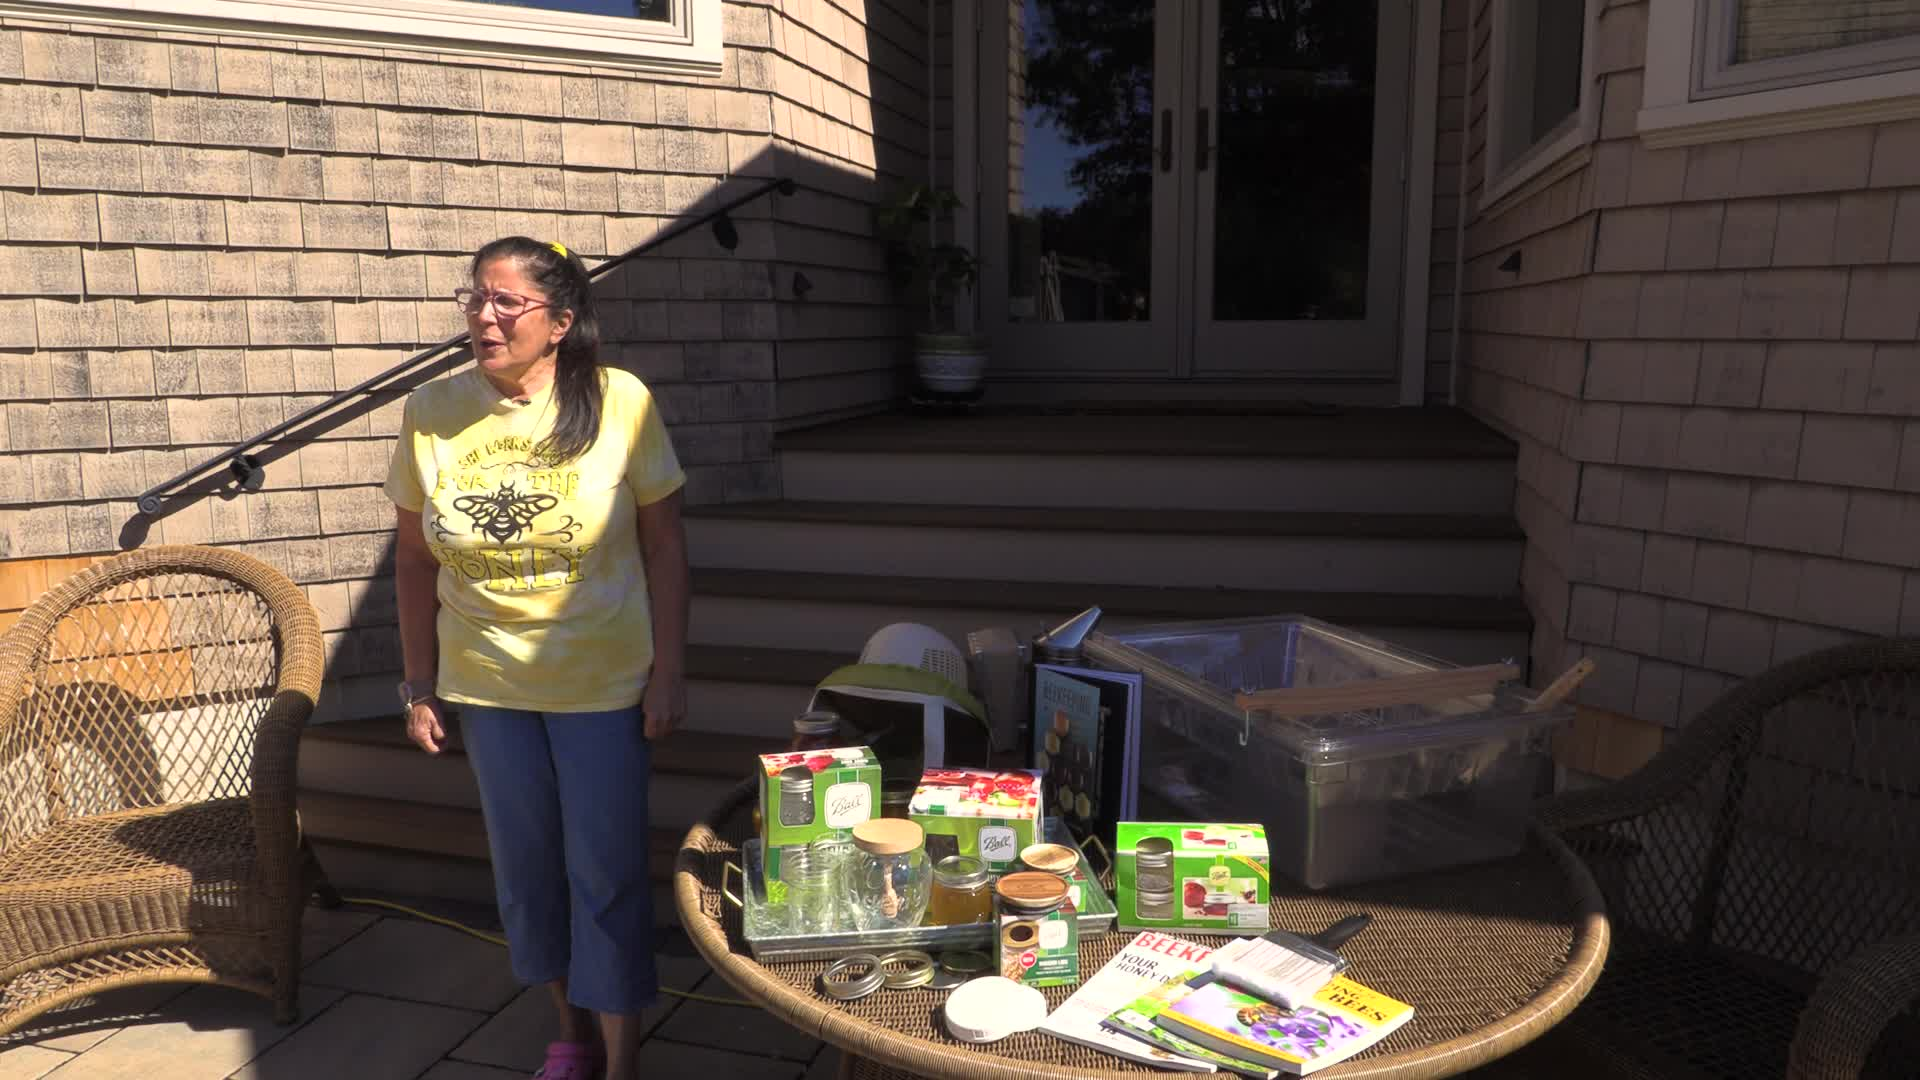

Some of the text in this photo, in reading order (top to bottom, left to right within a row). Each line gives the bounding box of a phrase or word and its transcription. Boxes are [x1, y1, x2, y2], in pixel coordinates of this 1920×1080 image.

[831, 794, 864, 816] Ball
[984, 835, 1010, 852] Ball
[1121, 953, 1159, 970] YOUR
[1115, 962, 1159, 980] HONEY
[1329, 993, 1387, 1021] BEES
